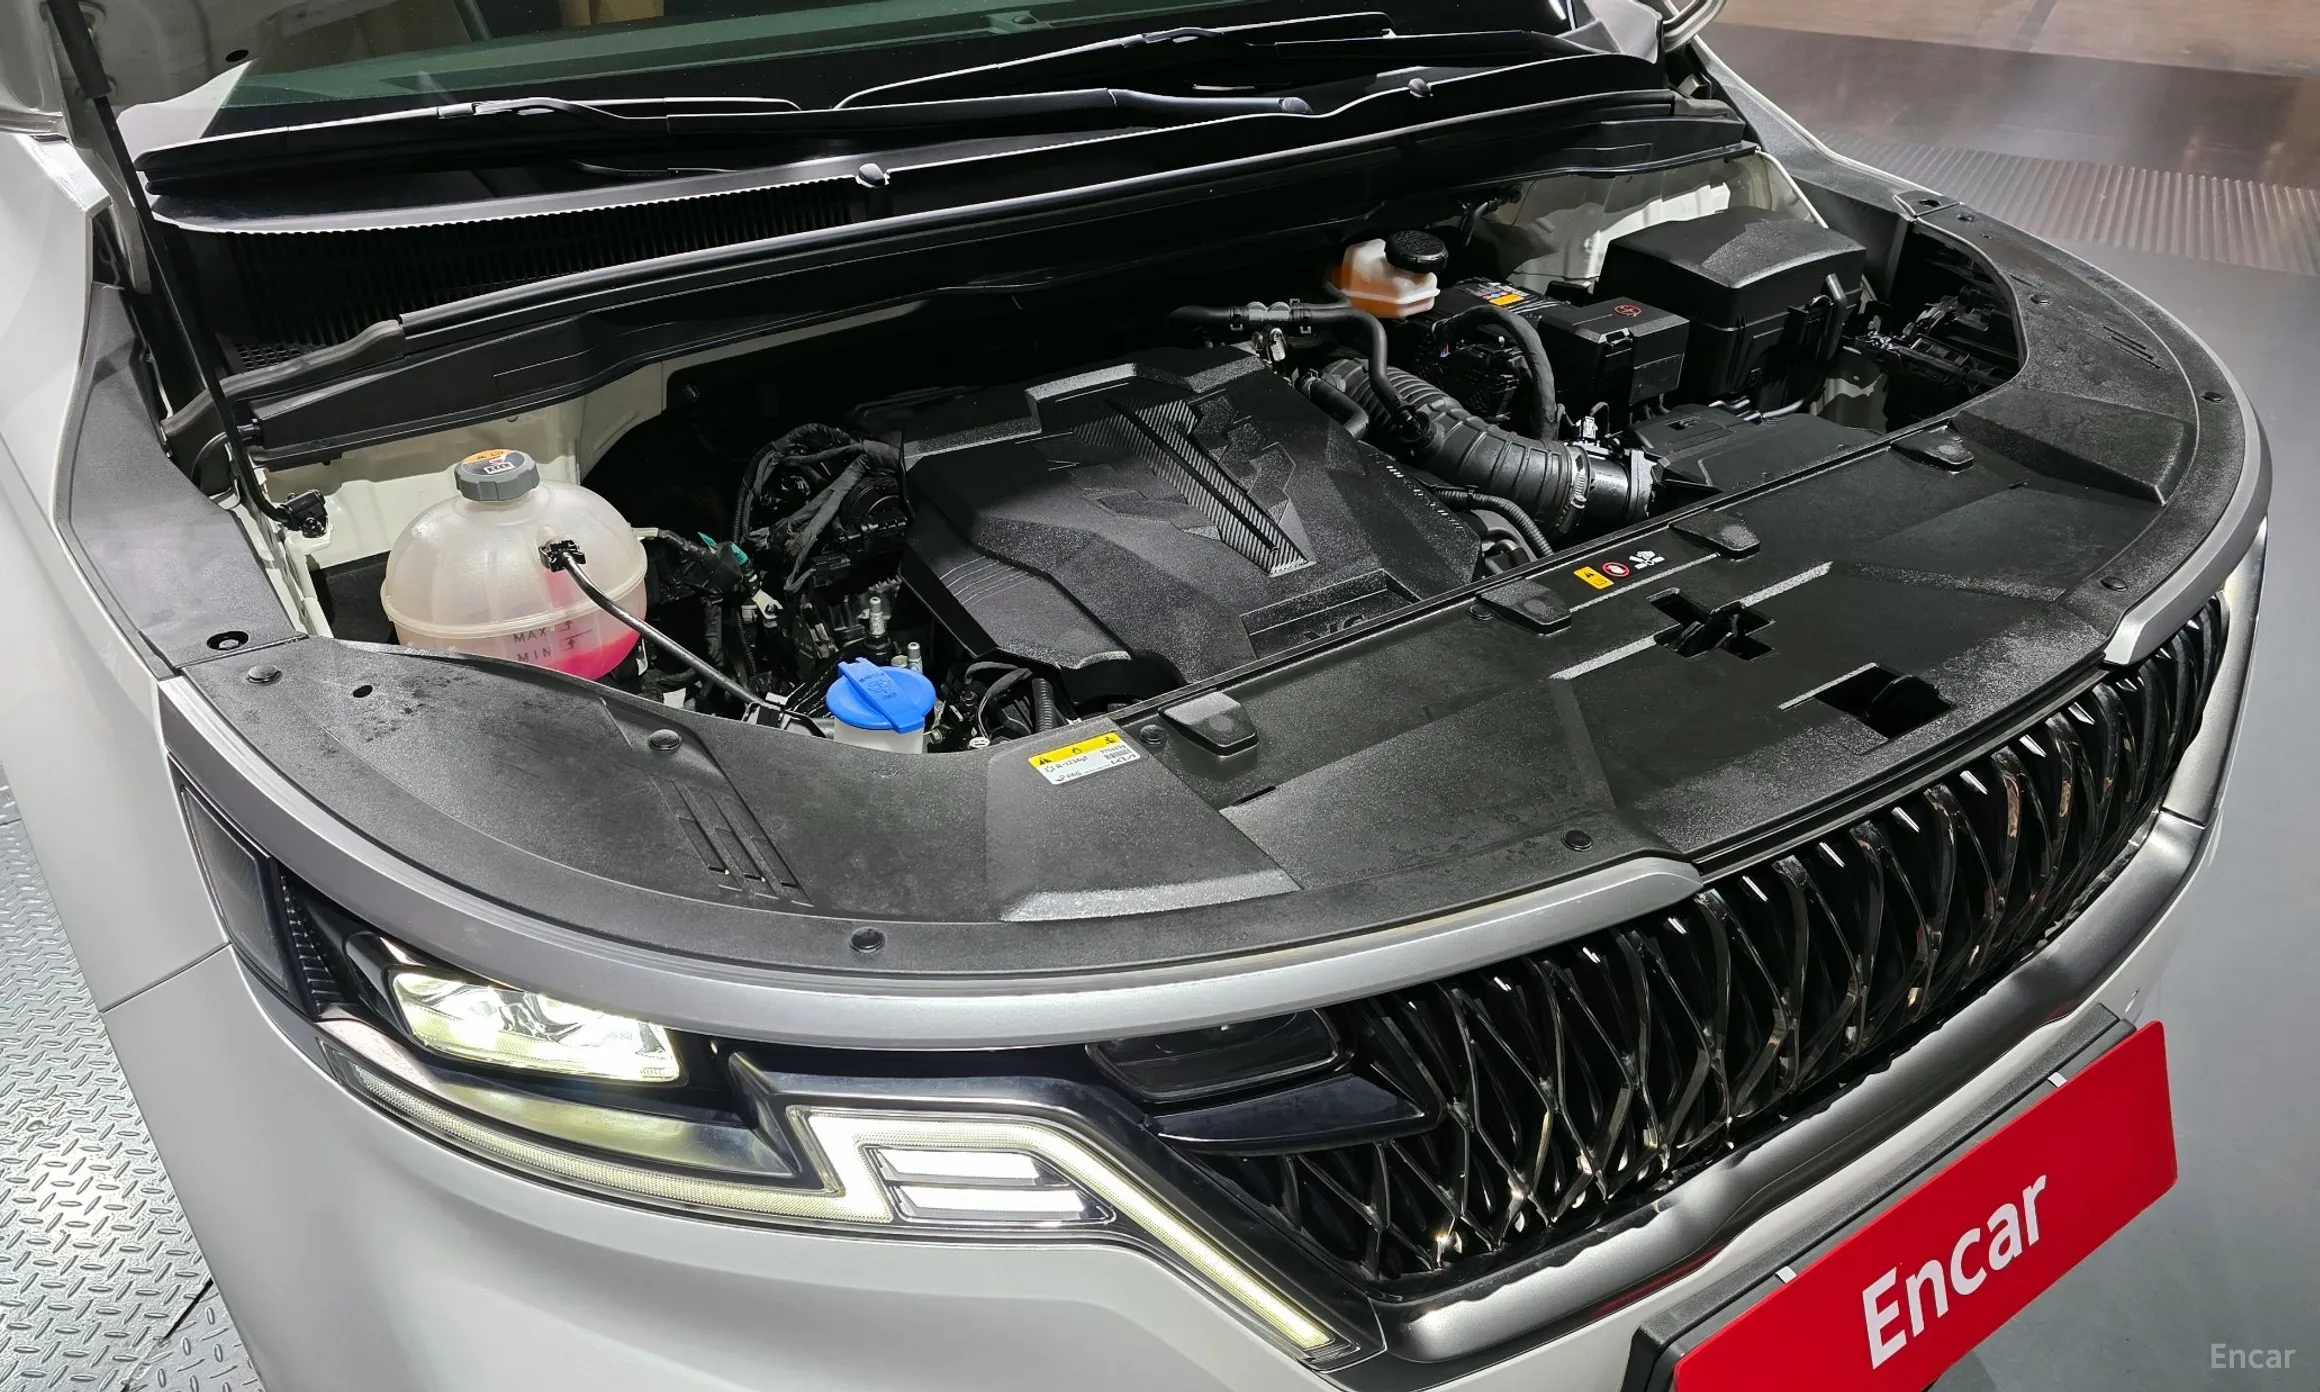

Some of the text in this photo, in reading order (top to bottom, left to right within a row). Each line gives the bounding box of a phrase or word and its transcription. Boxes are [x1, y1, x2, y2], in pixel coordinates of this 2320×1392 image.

[513, 626, 547, 643] MAX
[517, 647, 551, 662] MIN
[1862, 1174, 2047, 1370] Encar
